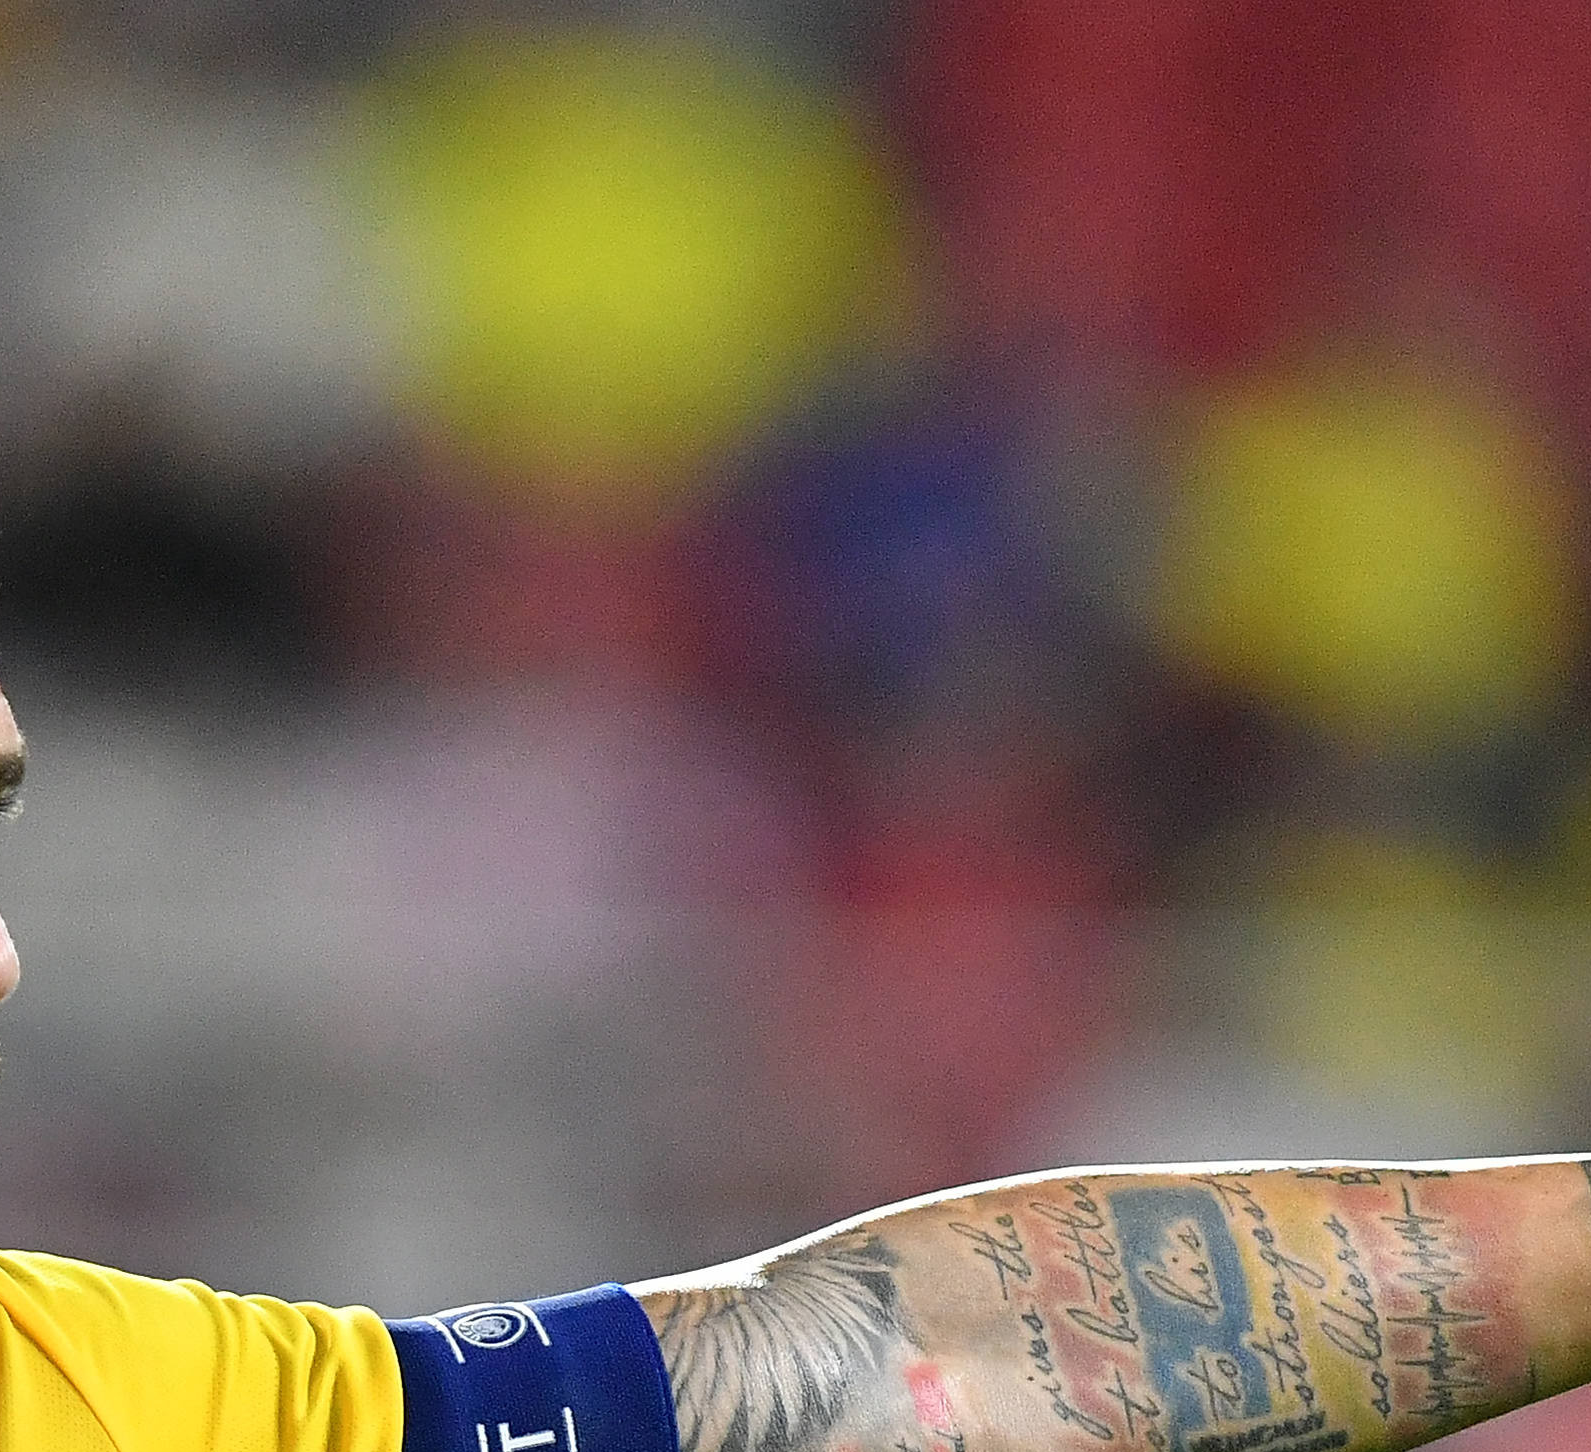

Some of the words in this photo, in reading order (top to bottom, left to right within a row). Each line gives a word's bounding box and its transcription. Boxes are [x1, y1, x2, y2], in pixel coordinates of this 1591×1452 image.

[950, 1215, 1032, 1300] the
[1144, 1222, 1220, 1321] his
[1189, 1355, 1240, 1424] to
